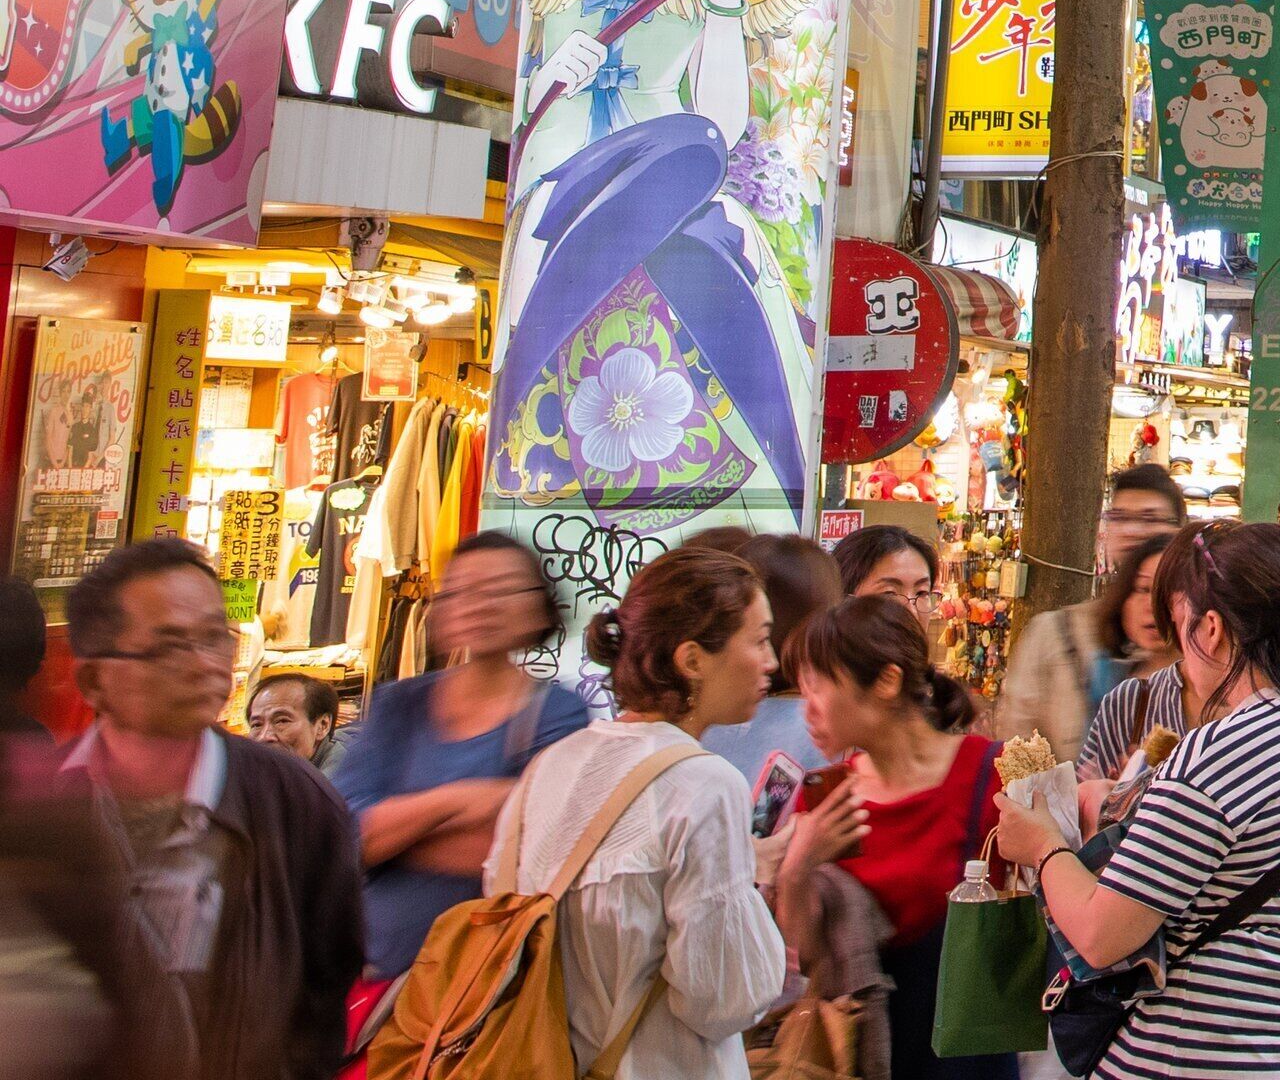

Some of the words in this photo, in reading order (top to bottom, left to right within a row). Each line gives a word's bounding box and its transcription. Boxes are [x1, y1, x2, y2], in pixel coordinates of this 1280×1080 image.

[1177, 25, 1267, 50] 西門町
[949, 109, 1014, 132] 西門町
[1198, 199, 1223, 209] Happy
[1226, 201, 1251, 210] Happy
[1261, 334, 1280, 358] E
[248, 517, 264, 580] minute
[240, 593, 255, 604] Size
[226, 606, 254, 620] 00NT
